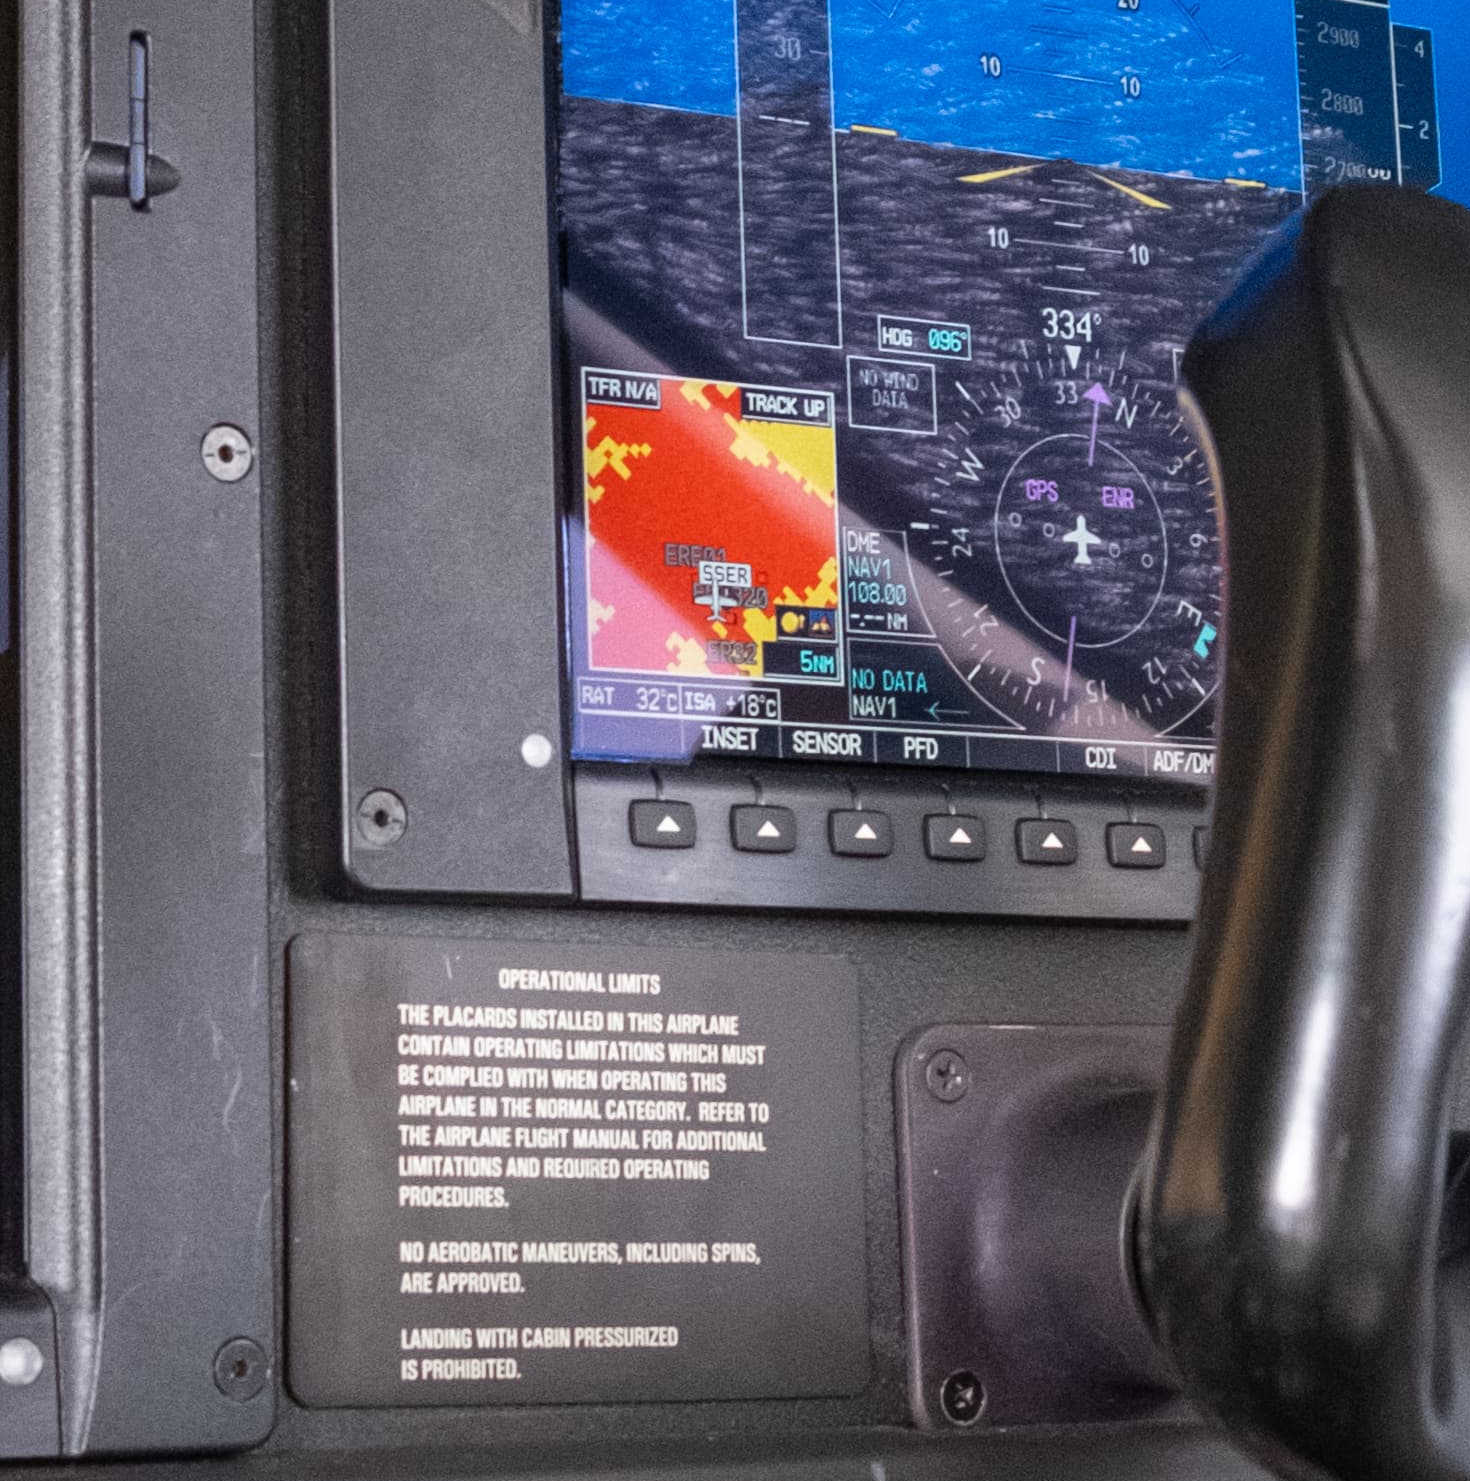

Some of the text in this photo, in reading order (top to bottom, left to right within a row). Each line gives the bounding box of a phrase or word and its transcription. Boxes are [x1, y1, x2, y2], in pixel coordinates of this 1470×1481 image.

[746, 393, 825, 417] TRACK UP
[1025, 480, 1058, 503] GPS
[800, 650, 835, 674] 5NM
[582, 686, 614, 705] RAT
[684, 691, 716, 710] ISA
[702, 727, 759, 751] INSET
[793, 731, 862, 756] SENSOR
[904, 738, 938, 759] PFD
[1086, 748, 1117, 769] CDI
[499, 969, 660, 995] OPERATIONAL LIMITS
[398, 1004, 739, 1036] THE PLACARDS INSTALLED IN THIS AIRPLANE
[398, 1035, 765, 1065] CONTAIN OPERATING LIMITATIONS WHICH MUST
